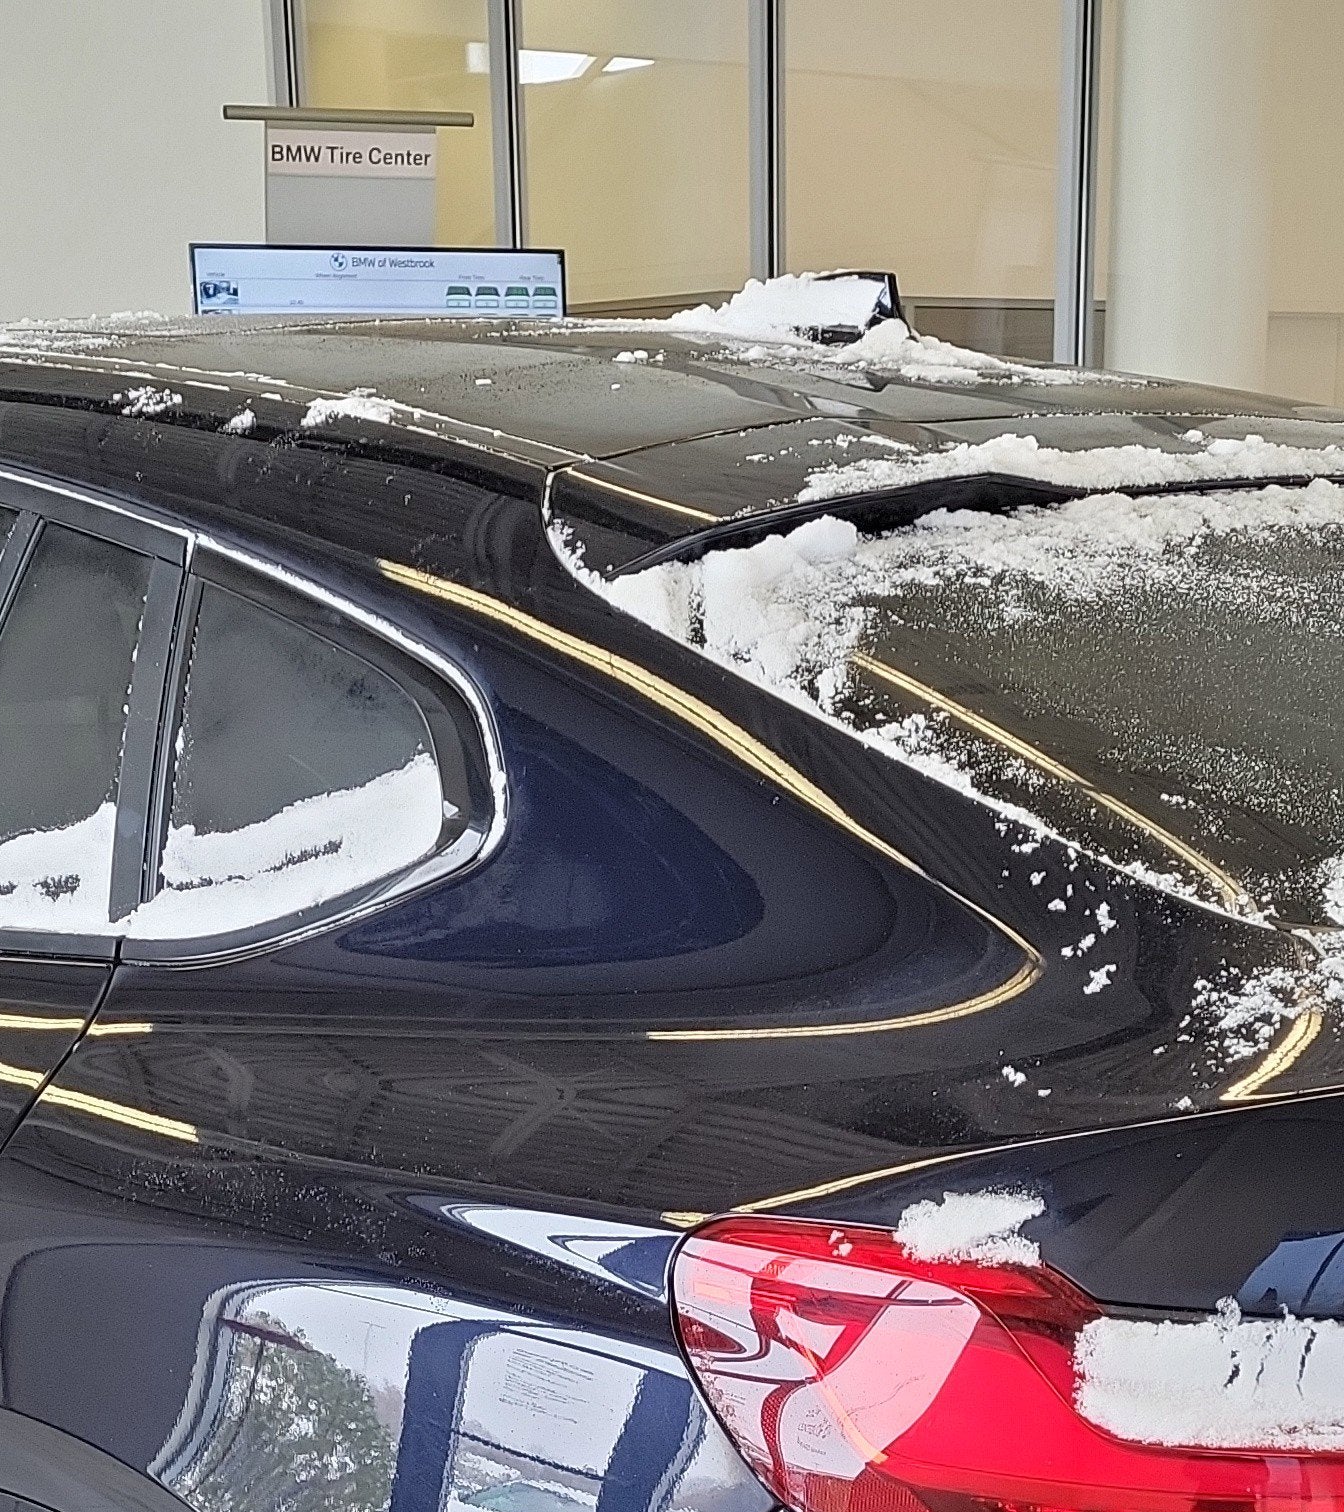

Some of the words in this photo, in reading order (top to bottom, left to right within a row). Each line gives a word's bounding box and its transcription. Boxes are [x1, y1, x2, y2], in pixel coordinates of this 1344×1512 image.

[271, 144, 321, 163] BMW
[326, 146, 363, 164] Tire
[368, 147, 431, 166] Center
[351, 256, 376, 268] BMW
[377, 257, 387, 268] of
[388, 257, 435, 268] Westbrook
